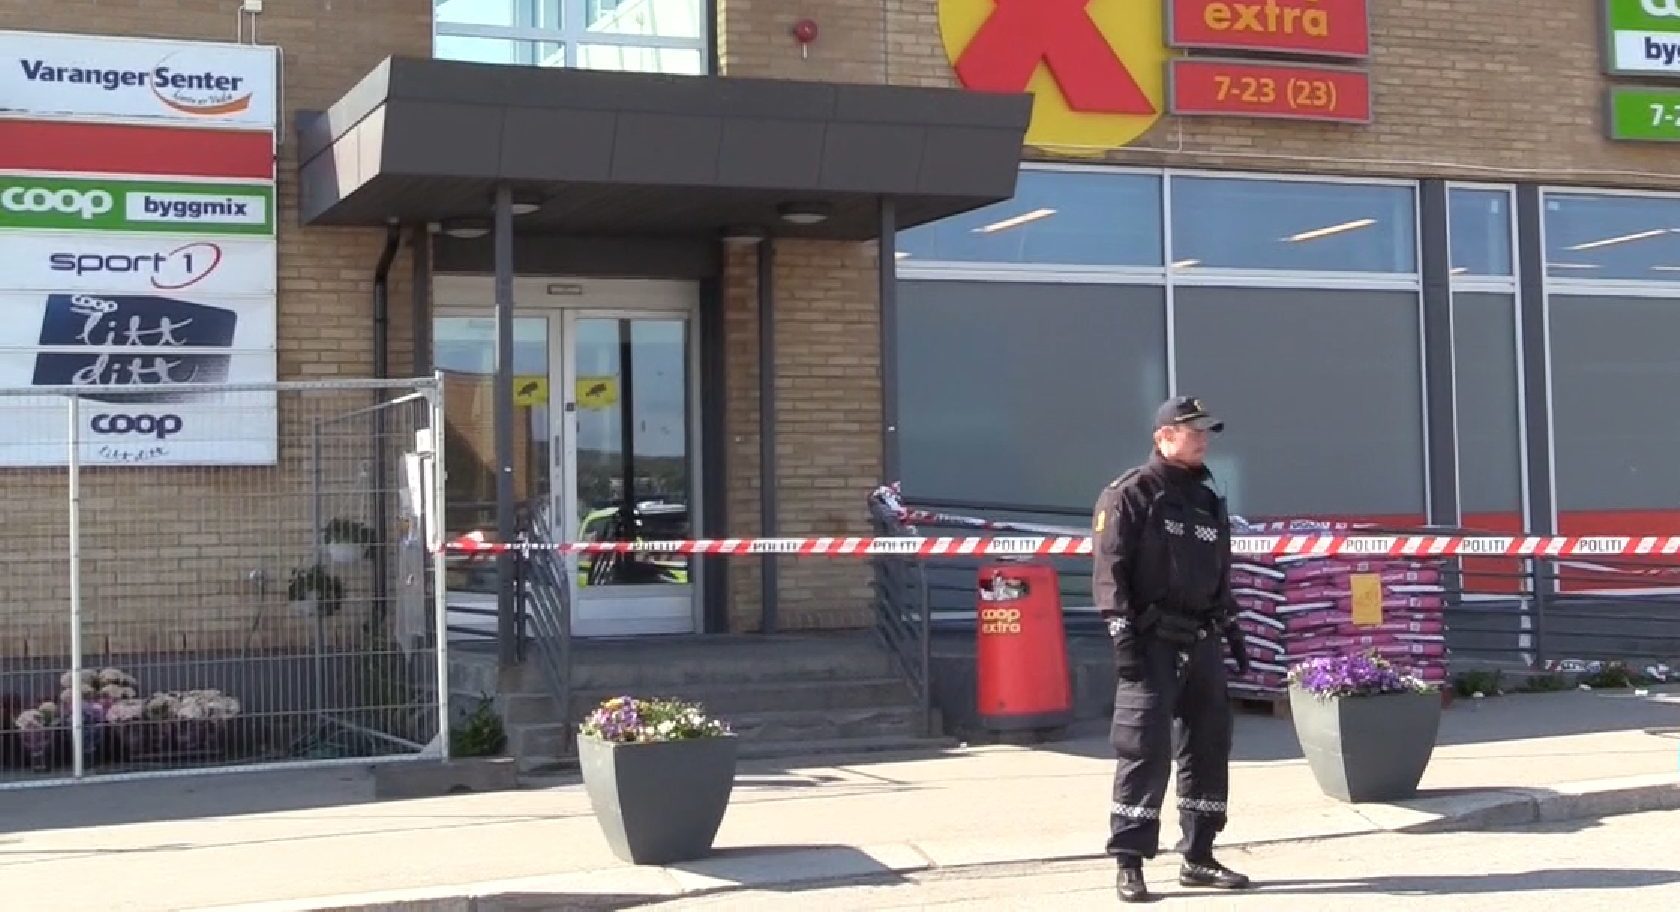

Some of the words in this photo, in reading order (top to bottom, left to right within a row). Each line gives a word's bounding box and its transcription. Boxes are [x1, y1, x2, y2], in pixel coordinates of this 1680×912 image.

[1204, 0, 1328, 36] extra
[1644, 36, 1680, 65] by
[21, 60, 149, 90] Varanger
[155, 67, 243, 91] Senter
[1214, 76, 1276, 102] 7-23
[1287, 78, 1336, 111] (23)
[1, 187, 113, 219] coop
[144, 196, 247, 217] byggmix
[50, 252, 166, 275] sport
[183, 253, 193, 273] 1
[91, 414, 183, 439] coop
[753, 542, 797, 551] POLITI
[873, 540, 917, 550] POLITI
[993, 539, 1036, 550] POLITI
[1347, 539, 1388, 552] POLITI
[1463, 539, 1505, 552] POLITI
[1578, 539, 1622, 552] POLITI
